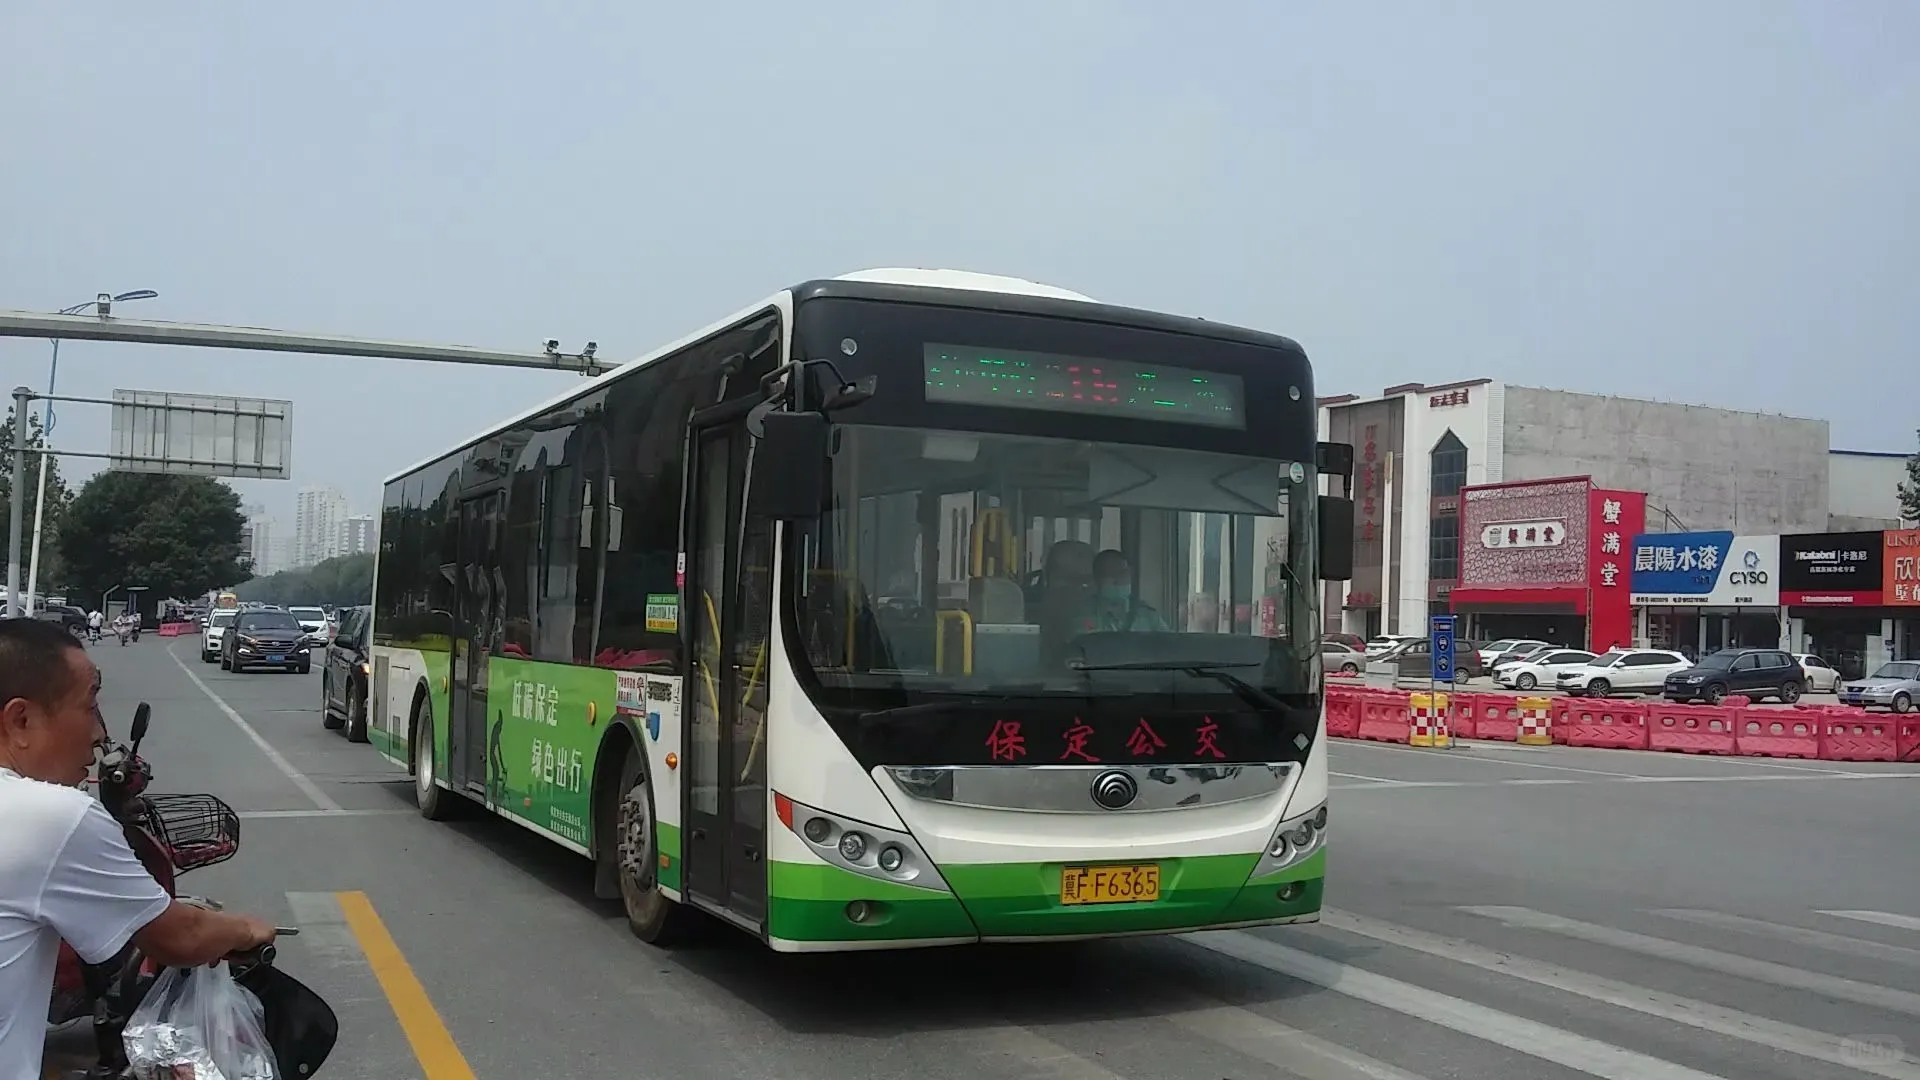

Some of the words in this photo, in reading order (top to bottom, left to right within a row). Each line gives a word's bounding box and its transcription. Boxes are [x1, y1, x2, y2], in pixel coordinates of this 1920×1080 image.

[1600, 498, 1623, 587] 蟹满堂
[1634, 545, 1720, 572] 晨陽水漆
[512, 679, 560, 727] 低碳保定
[984, 714, 1227, 763] 保定公交
[530, 737, 583, 794] 绿色出行
